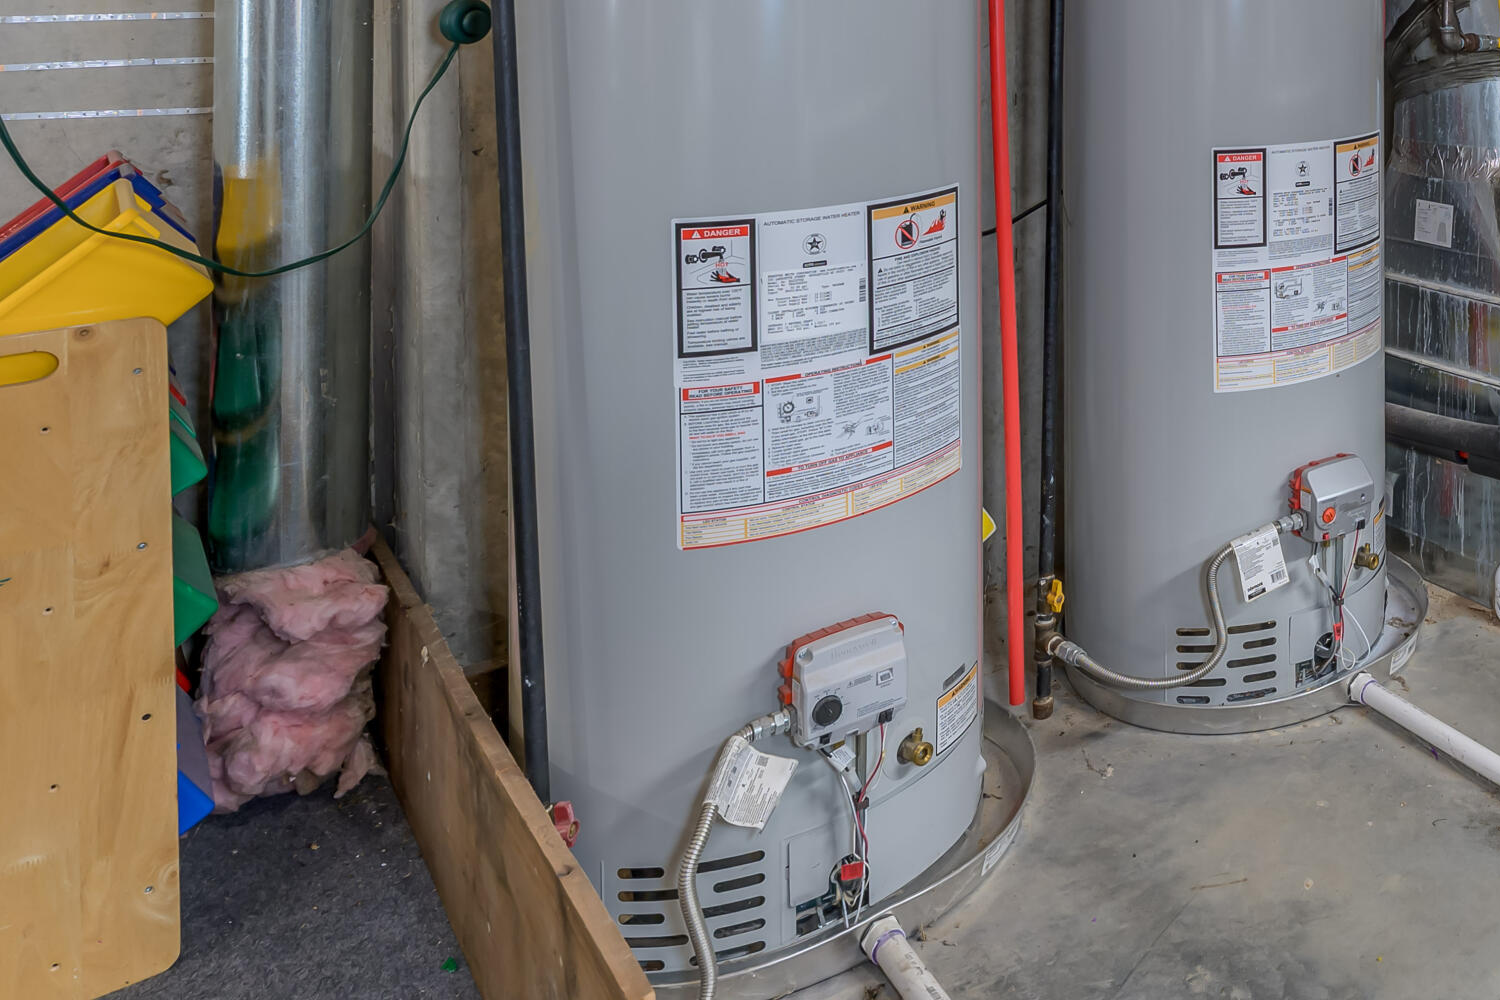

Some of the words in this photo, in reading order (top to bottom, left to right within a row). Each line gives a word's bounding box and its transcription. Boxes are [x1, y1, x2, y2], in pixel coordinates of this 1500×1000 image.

[1232, 154, 1257, 162] DANGER
[763, 216, 796, 227] AUTOMATIC
[797, 214, 822, 224] STORAGE
[703, 228, 741, 238] DANGER
